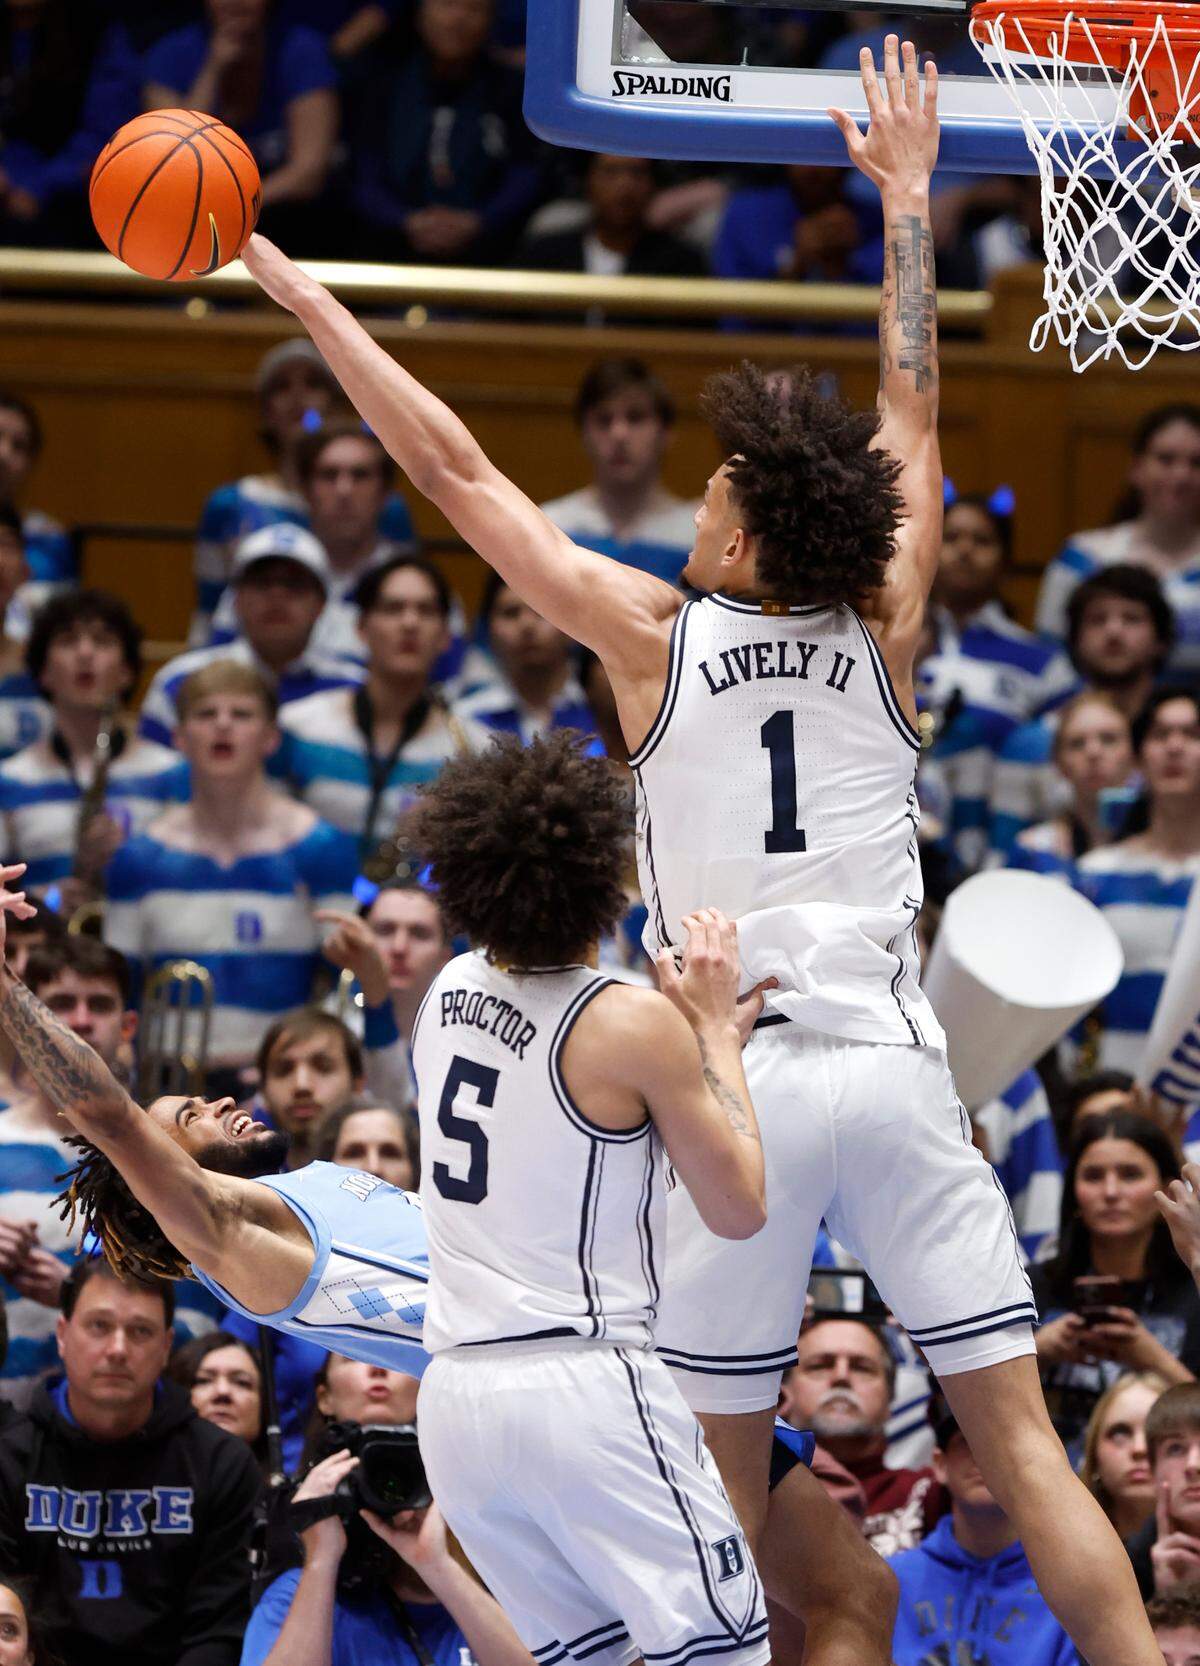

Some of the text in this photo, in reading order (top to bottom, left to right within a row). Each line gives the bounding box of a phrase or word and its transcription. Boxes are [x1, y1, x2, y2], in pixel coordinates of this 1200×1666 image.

[612, 71, 731, 102] SPALDING
[698, 641, 856, 696] LIVELY II
[761, 710, 806, 853] 1
[441, 989, 537, 1060] PROCTOR
[433, 1055, 500, 1205] 5
[25, 1483, 194, 1537] DUKE
[79, 1560, 122, 1598] D
